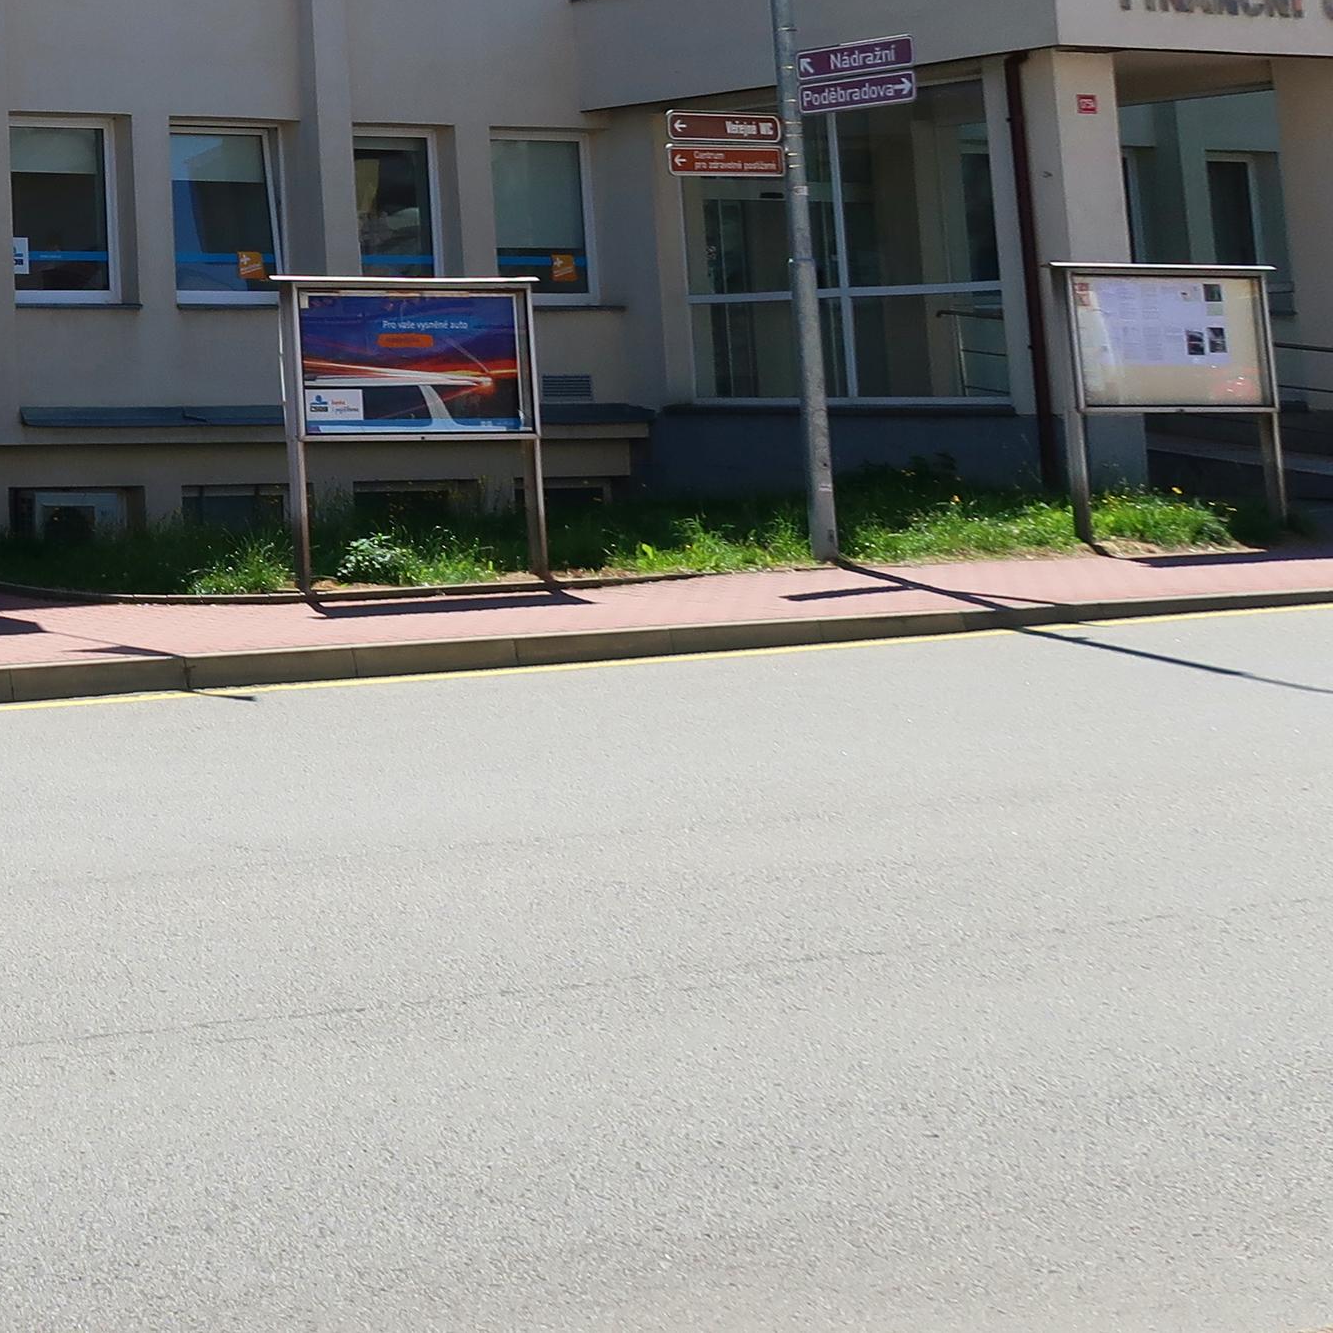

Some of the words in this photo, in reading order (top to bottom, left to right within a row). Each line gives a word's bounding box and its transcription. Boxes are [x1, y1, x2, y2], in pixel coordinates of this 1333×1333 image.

[829, 43, 896, 69] Nádražní
[802, 82, 895, 107] Poděbradova
[450, 321, 469, 329] auto
